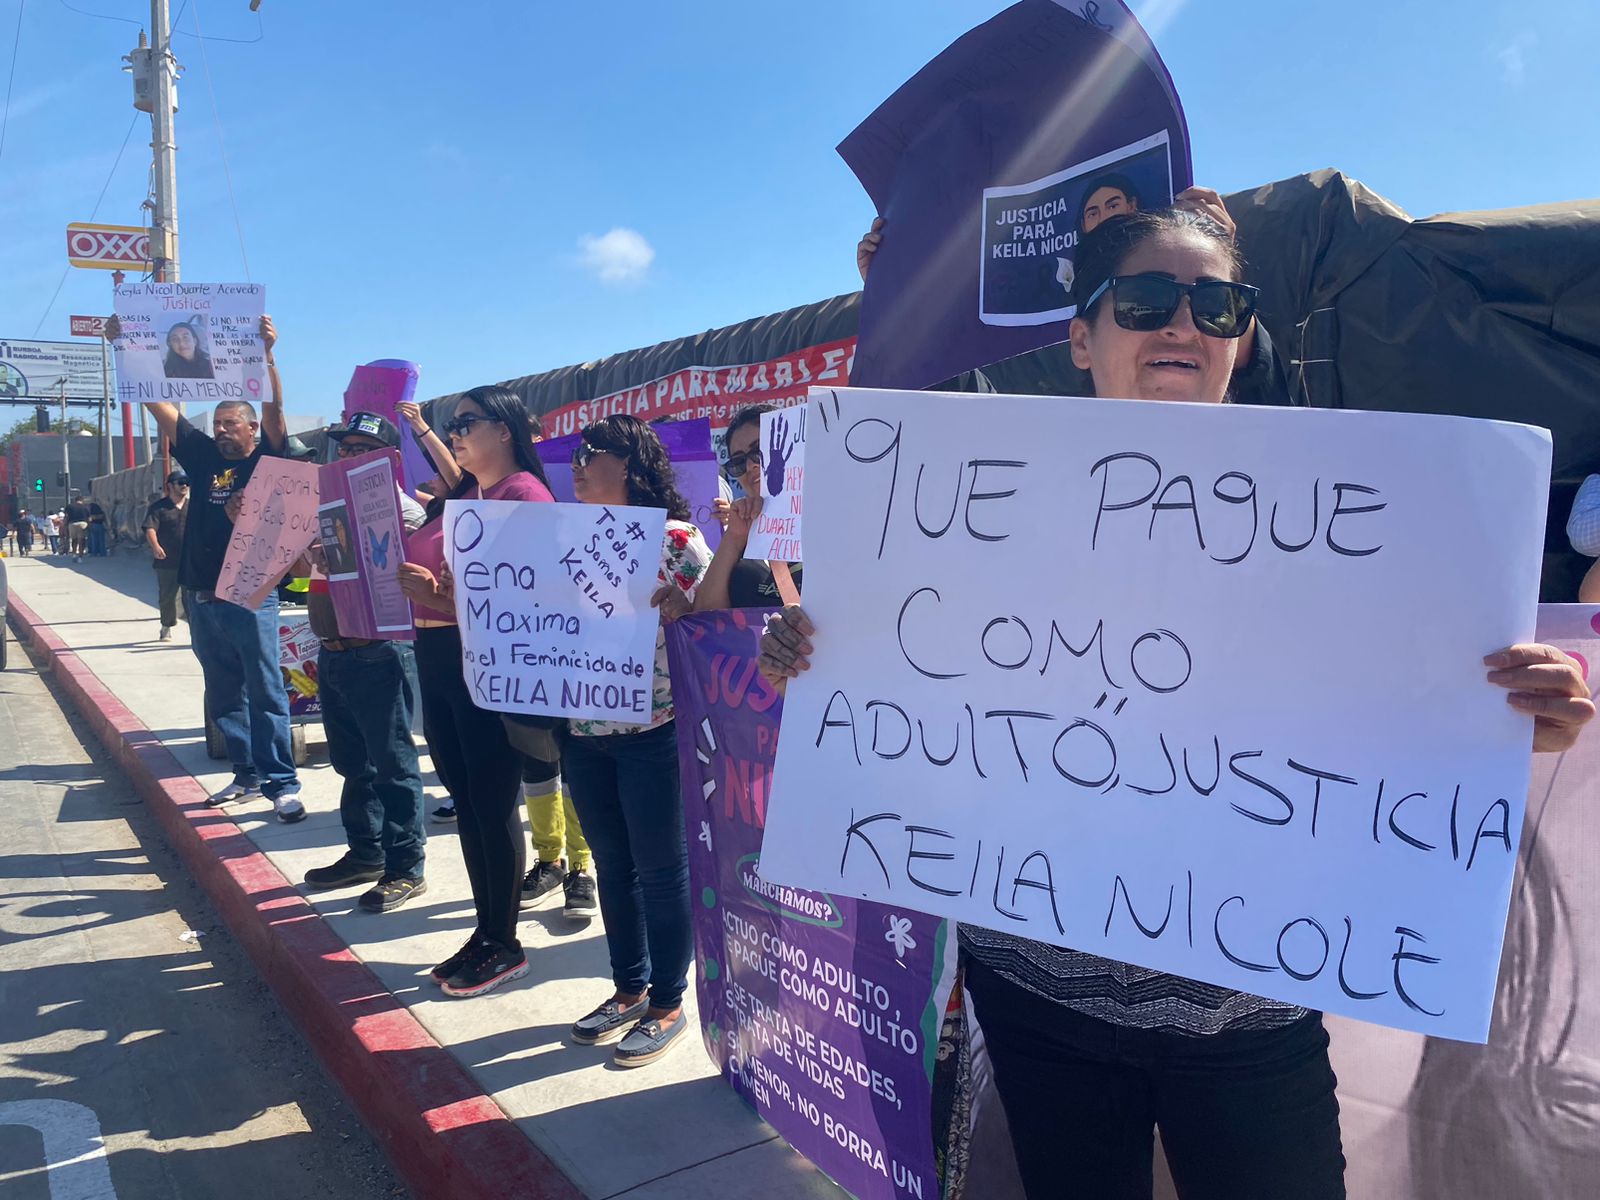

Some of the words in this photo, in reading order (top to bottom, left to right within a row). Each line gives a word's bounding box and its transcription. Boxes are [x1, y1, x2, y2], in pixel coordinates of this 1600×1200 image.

[996, 198, 1067, 225] JUSTICIA
[1013, 220, 1055, 240] PARA
[992, 242, 1036, 259] KEILA
[145, 283, 173, 295] Nicol
[176, 283, 210, 295] Duarte
[217, 284, 258, 295] Acevedo
[161, 382, 191, 399] UNA
[197, 382, 243, 399] MENOS
[551, 386, 649, 438] JUSTICIA
[656, 370, 720, 408] PARA
[596, 507, 640, 575] Todos
[758, 514, 796, 535] DUARTE
[559, 547, 614, 619] KEILA
[584, 533, 622, 588] Somos
[466, 598, 580, 635] Maxima
[898, 587, 1191, 693] COMO
[473, 668, 549, 706] KEILA
[561, 678, 646, 713] NICOLE
[621, 656, 645, 678] de
[1125, 733, 1511, 871] JUSTICIA
[743, 872, 832, 922] MARCHAMOS?
[841, 808, 1065, 935] KEILA
[1105, 870, 1446, 1016] NICOLE
[761, 932, 807, 971] COMO
[735, 943, 777, 983] PAGUE
[781, 969, 830, 1011] COMO
[834, 997, 918, 1055] ADULTO
[734, 982, 747, 1007] SE
[748, 993, 791, 1040] TRATA
[795, 1024, 817, 1056] DE
[819, 1040, 902, 1111] EDADES,
[734, 1003, 771, 1049] TRATA
[773, 1036, 793, 1065] DE
[795, 1049, 846, 1100] VIDAS
[745, 1051, 795, 1110] MENOR,
[797, 1093, 820, 1126] NO
[823, 1113, 888, 1178] BORRA
[892, 1160, 923, 1200] UN
